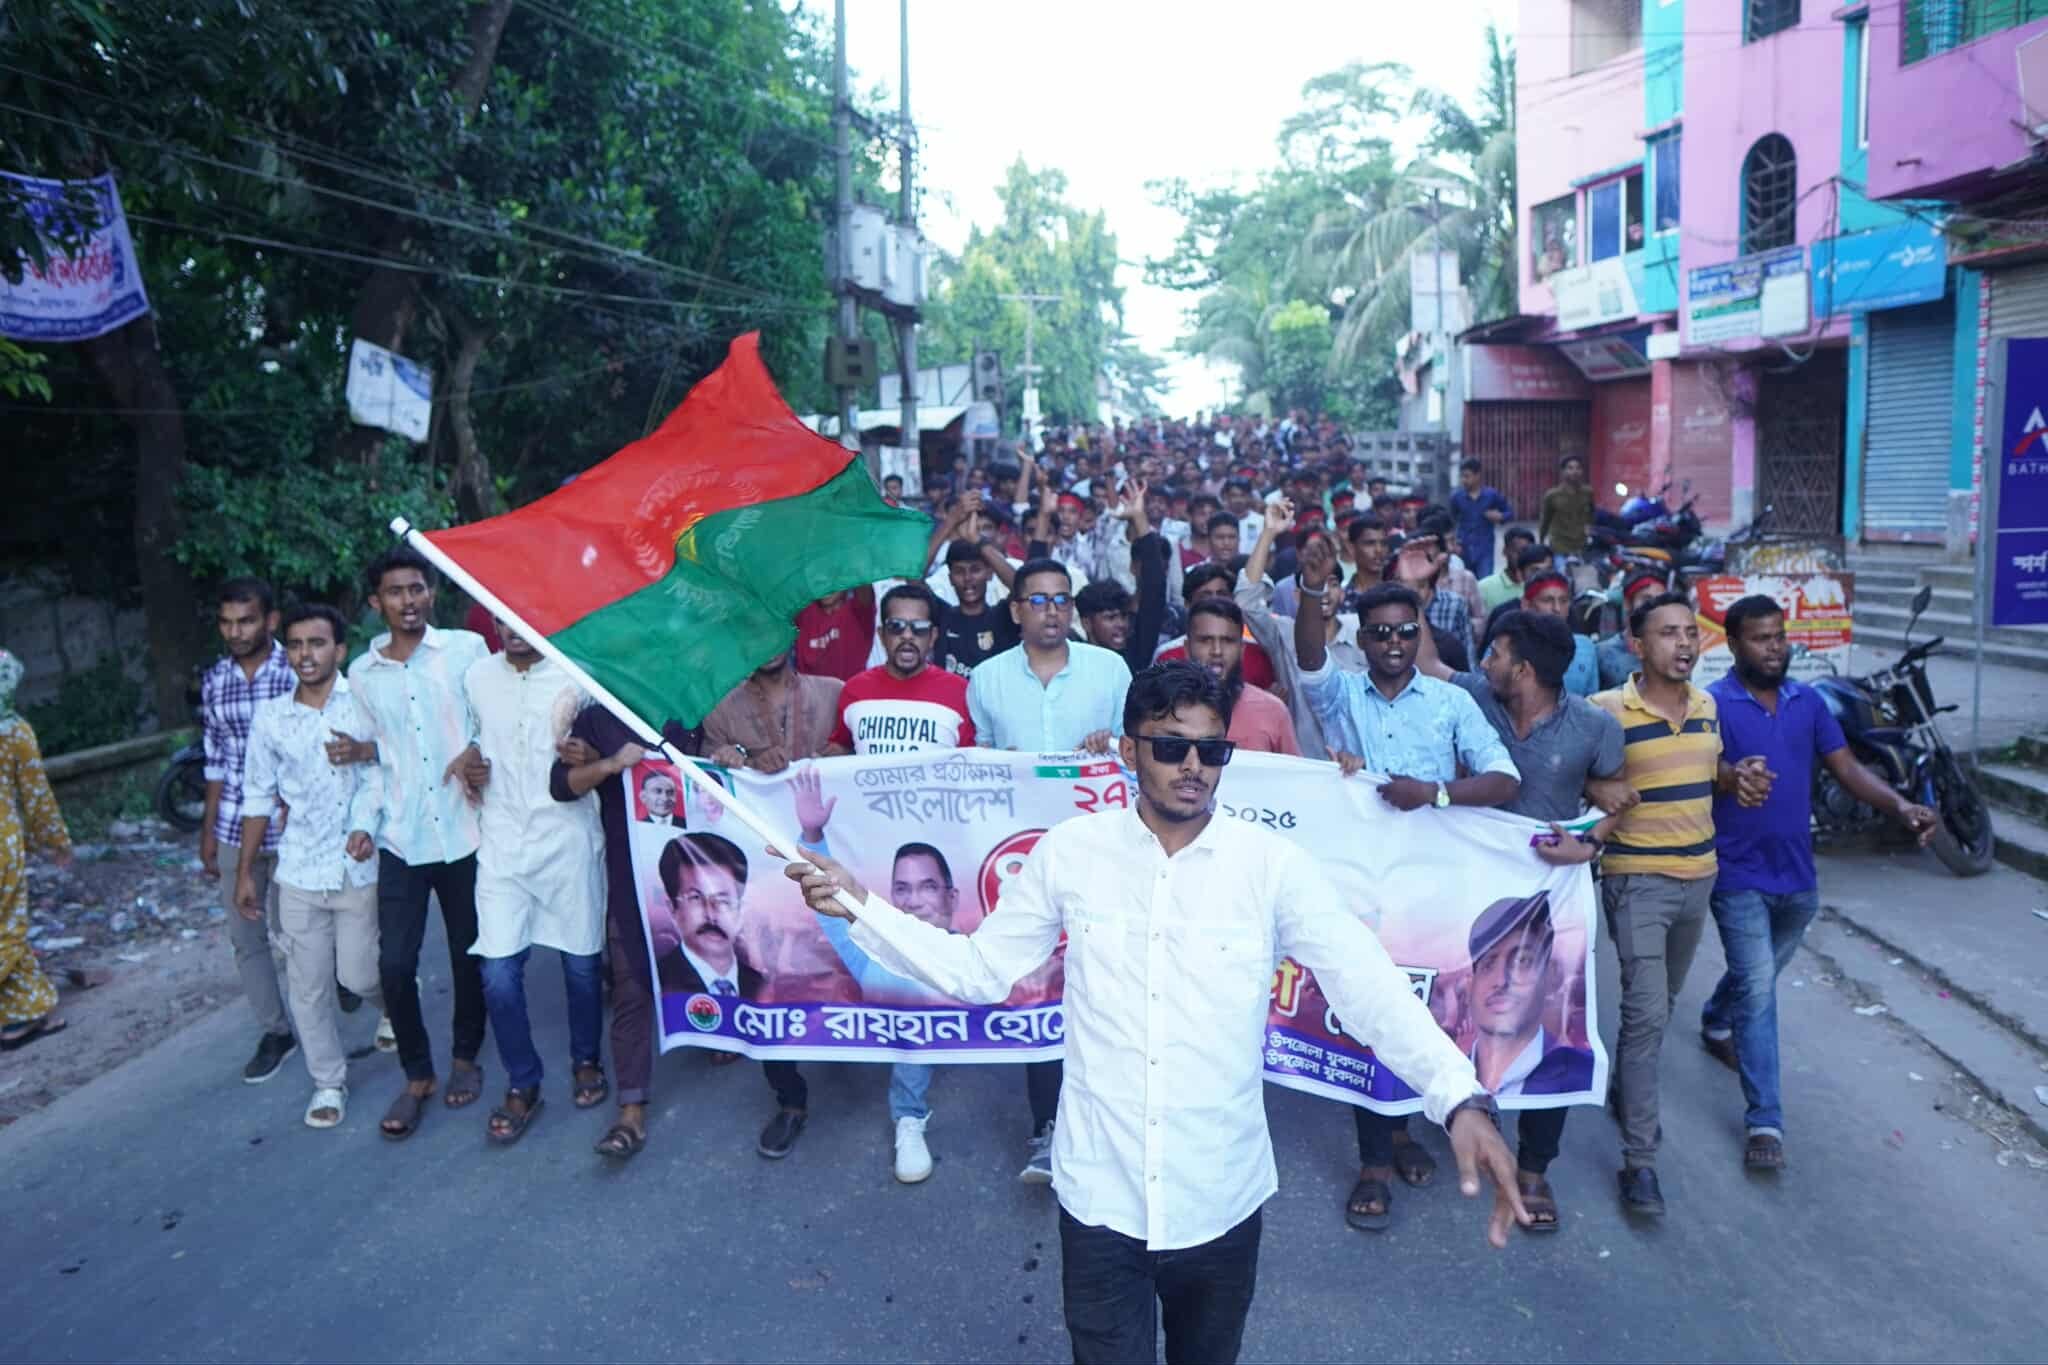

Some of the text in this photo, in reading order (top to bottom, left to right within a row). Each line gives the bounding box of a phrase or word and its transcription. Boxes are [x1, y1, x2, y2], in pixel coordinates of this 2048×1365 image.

[858, 715, 938, 744] CHIROYAL
[854, 753, 1013, 787] তোমার প্রতীক্ষায়
[863, 787, 1015, 825] বাংলাদেশ
[1073, 780, 1128, 814] ২৭
[733, 1003, 808, 1039] মোঃ
[820, 1006, 969, 1045] রায়হান
[1265, 1048, 1320, 1075] উপজেলা
[1269, 1031, 1324, 1060] উপজেলা
